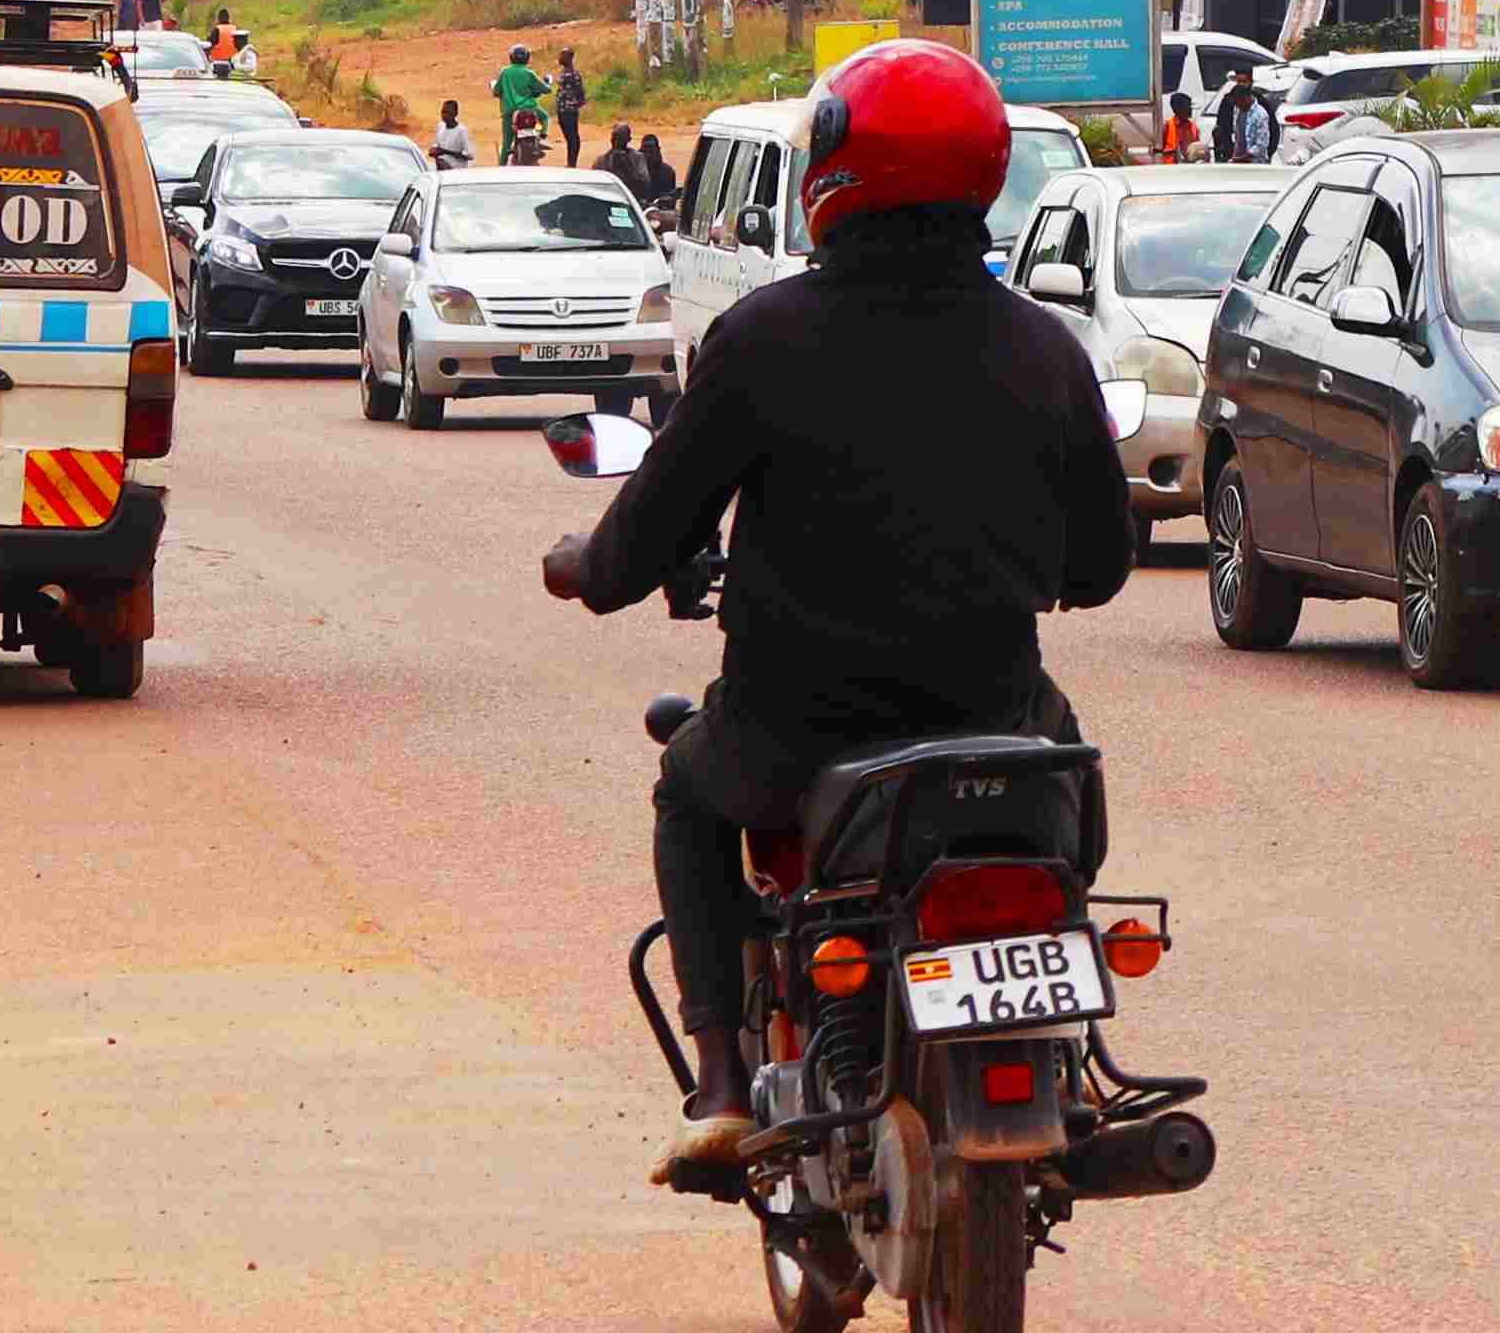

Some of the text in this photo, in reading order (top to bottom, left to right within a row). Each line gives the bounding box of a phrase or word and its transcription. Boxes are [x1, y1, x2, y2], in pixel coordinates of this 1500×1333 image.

[997, 1, 1023, 11] SPA
[998, 18, 1124, 32] ACCOMMODATION
[998, 38, 1130, 52] CONFERENCE HALL
[318, 301, 341, 314] UBS
[951, 777, 1008, 798] TVS
[973, 941, 1070, 984] UGB
[956, 981, 1082, 1024] 164B
